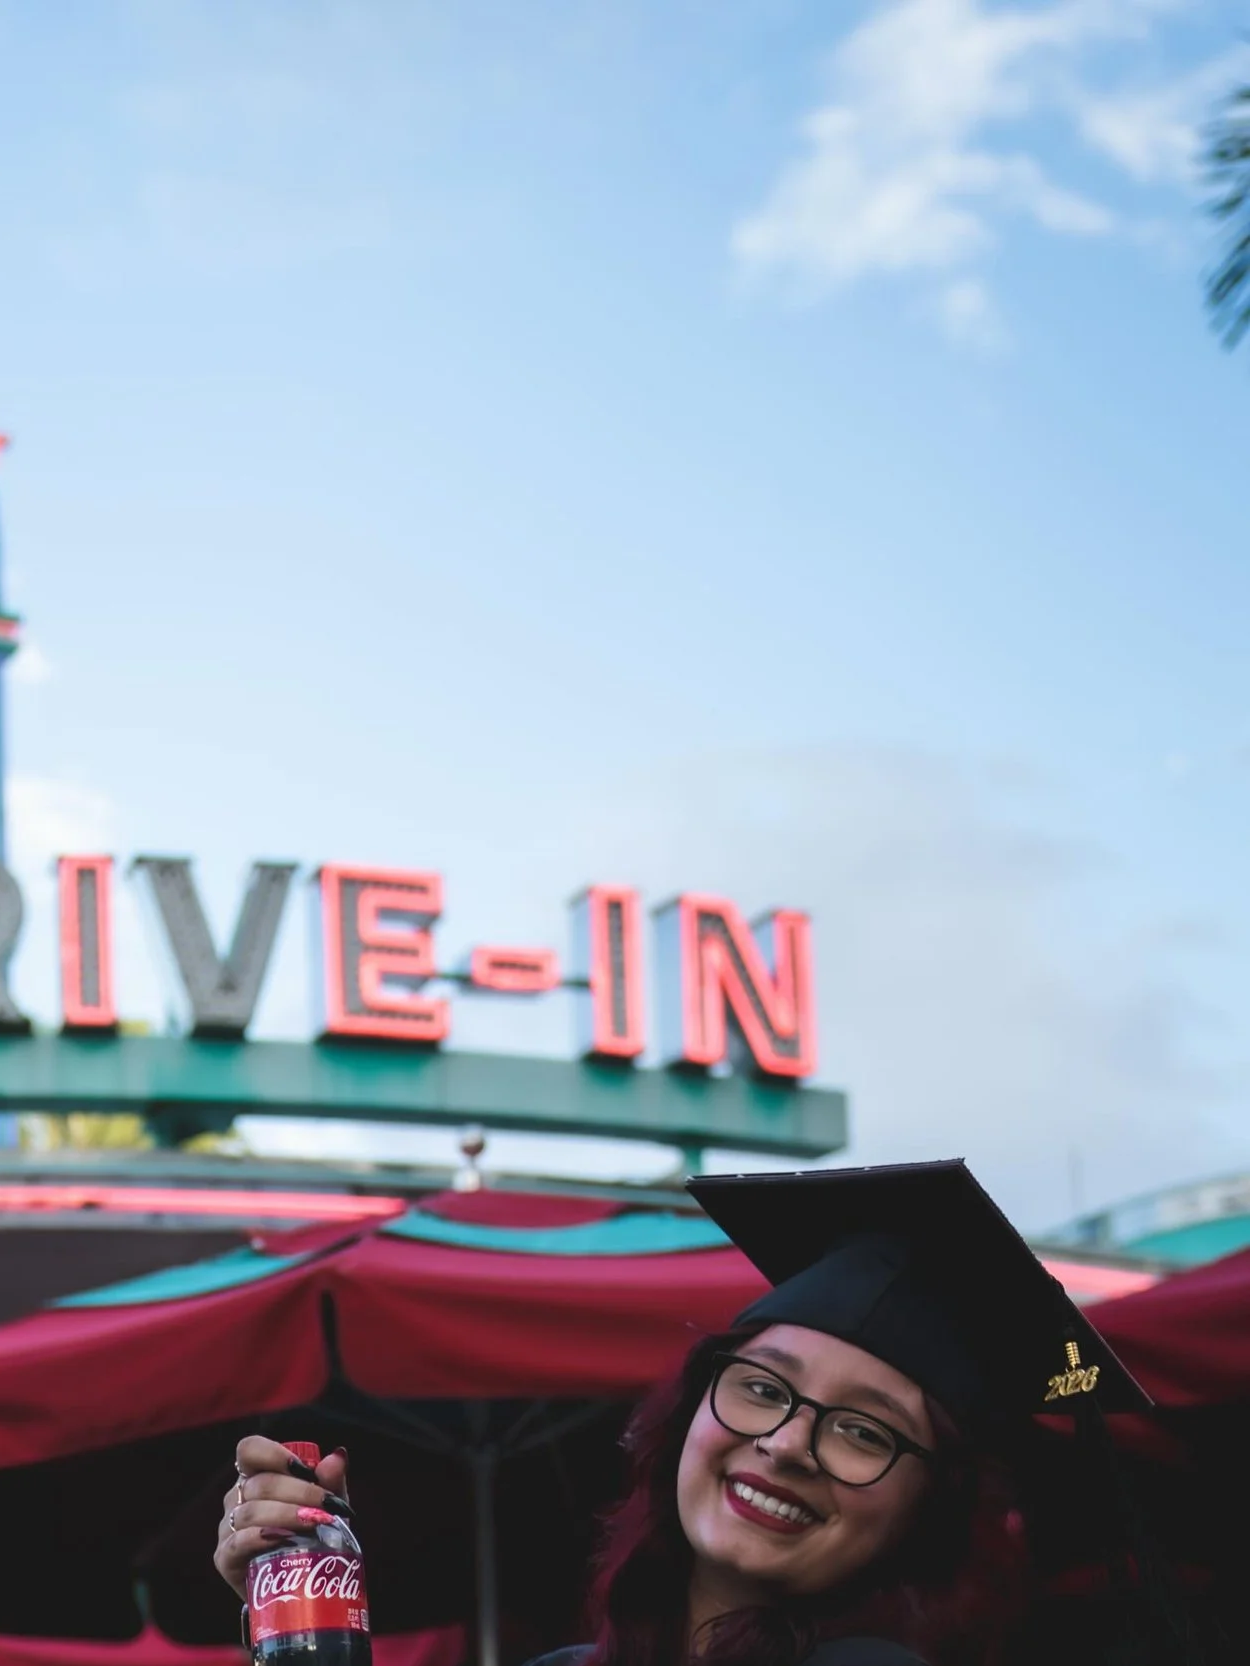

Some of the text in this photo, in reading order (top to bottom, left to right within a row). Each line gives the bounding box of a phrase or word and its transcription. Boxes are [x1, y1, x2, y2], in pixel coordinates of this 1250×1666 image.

[1045, 1366, 1100, 1401] 2026
[280, 1558, 313, 1568] Cherry
[253, 1555, 361, 1611] Coca-Cola
